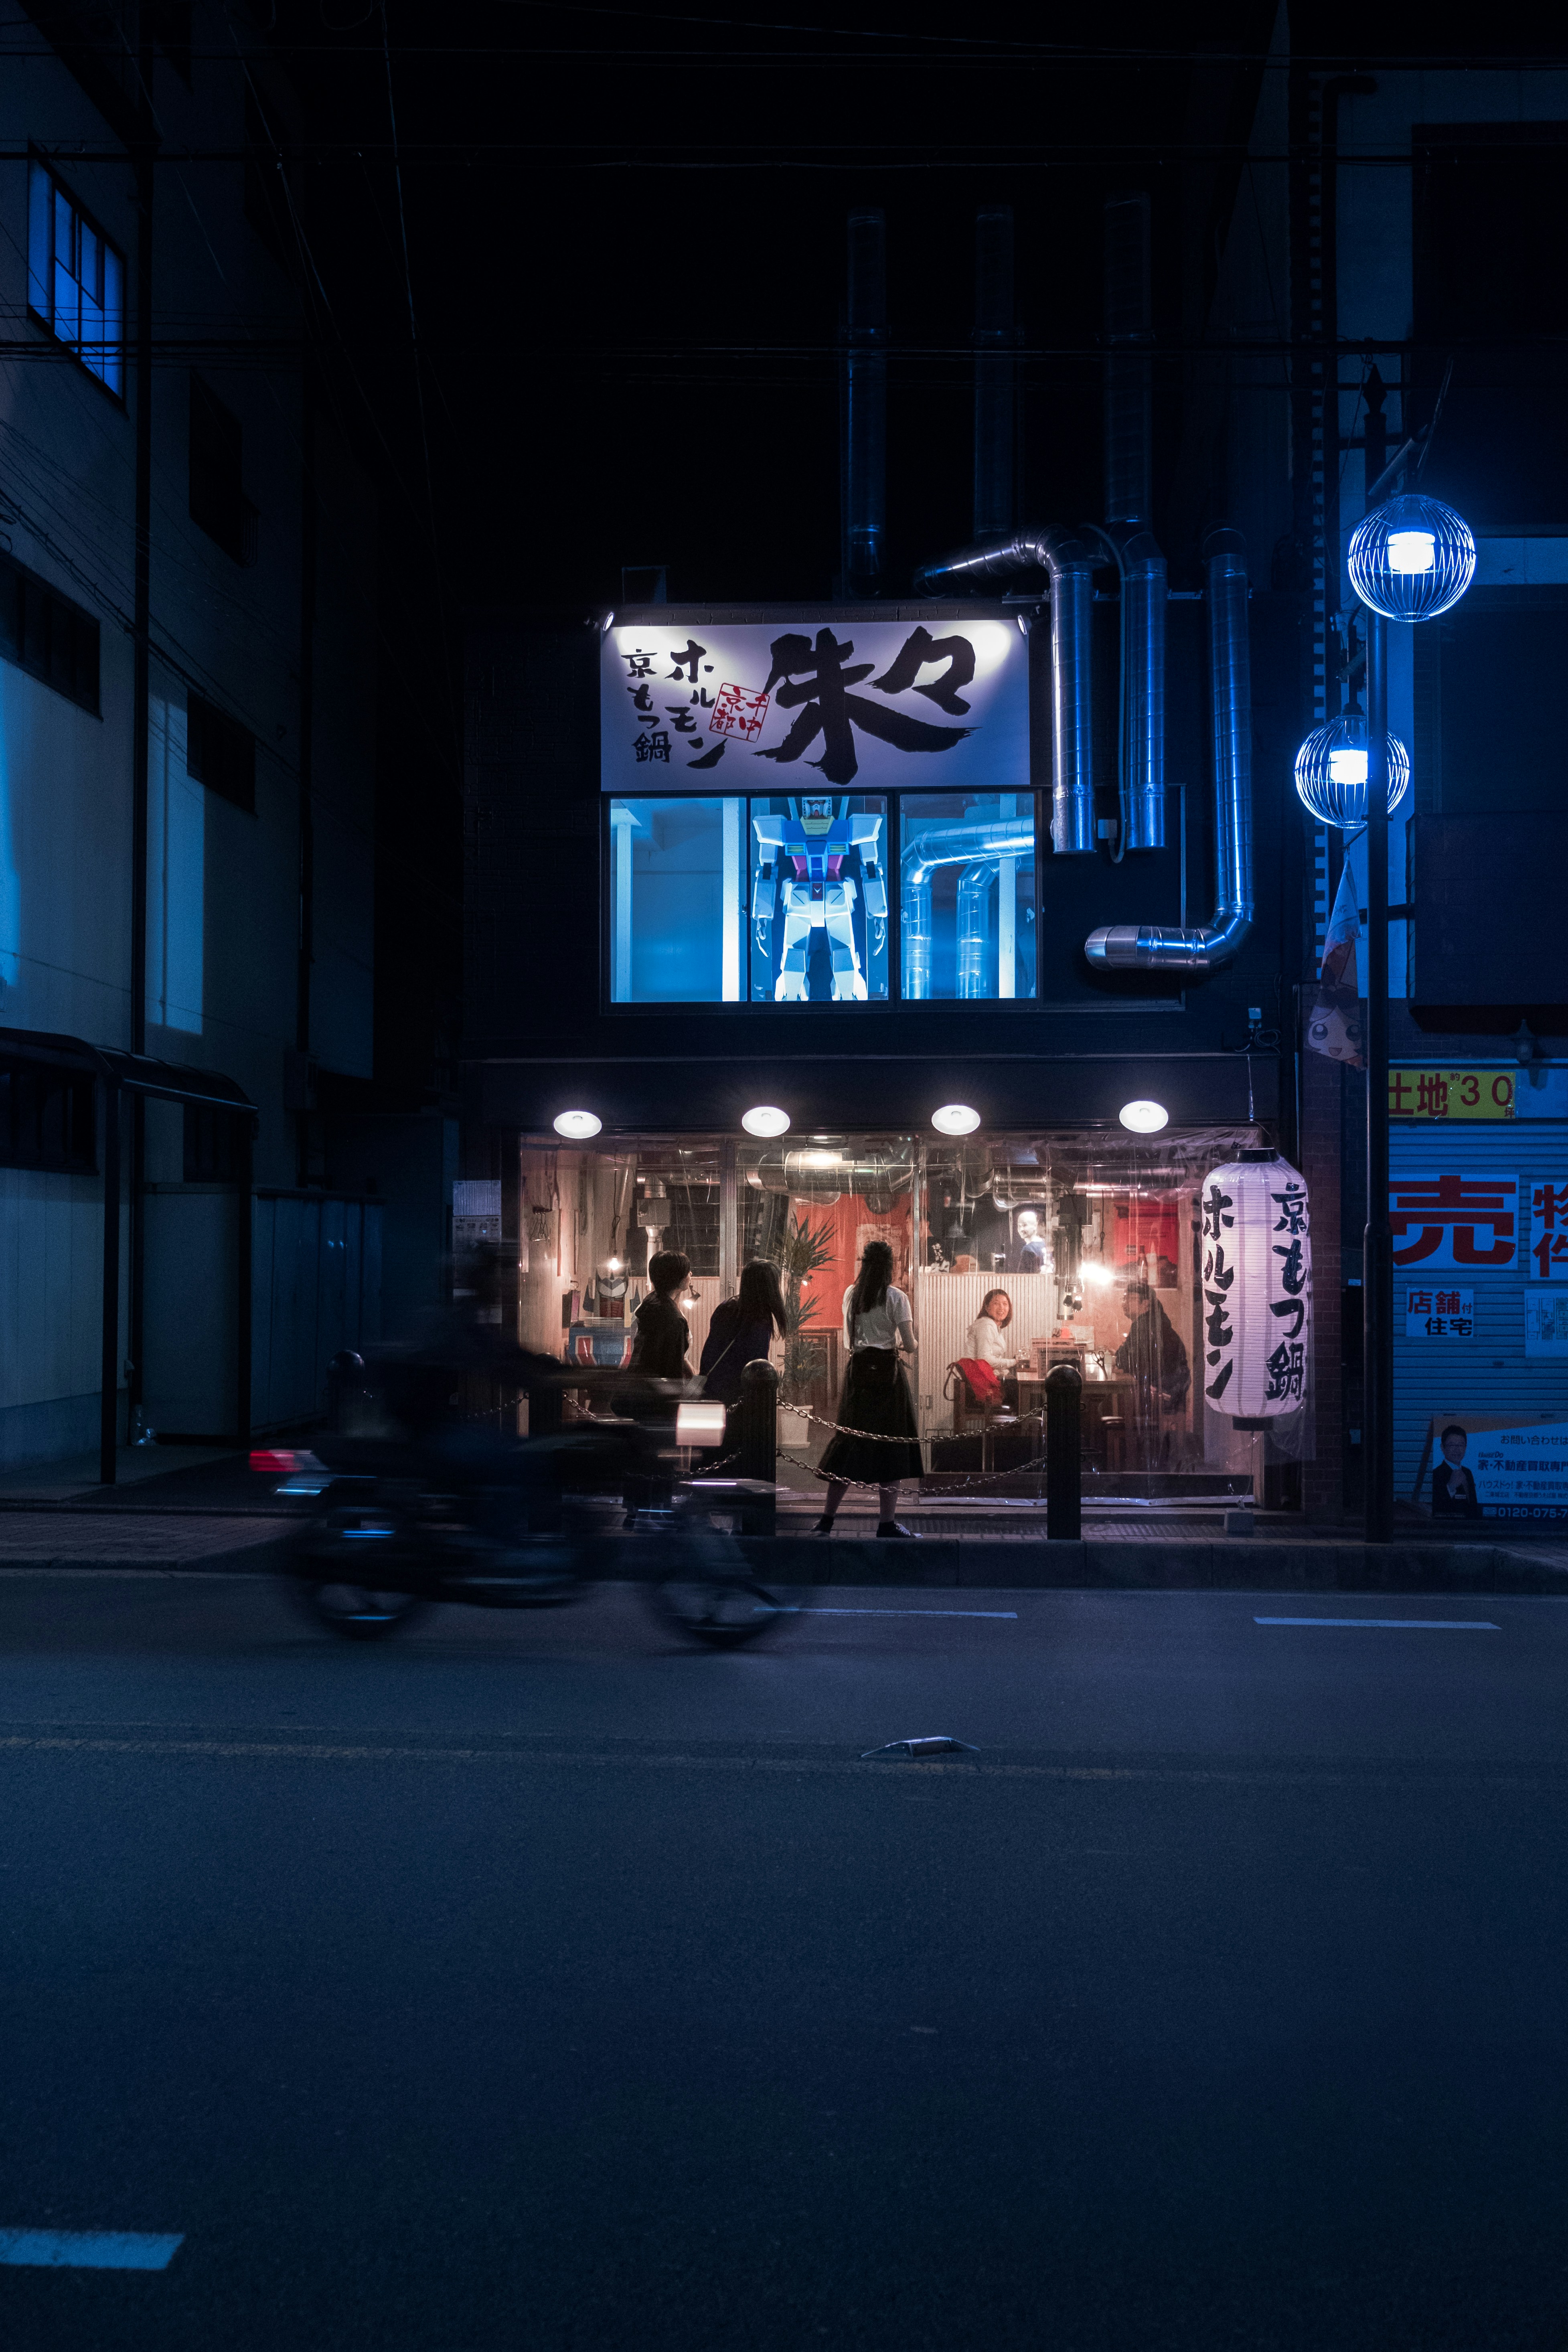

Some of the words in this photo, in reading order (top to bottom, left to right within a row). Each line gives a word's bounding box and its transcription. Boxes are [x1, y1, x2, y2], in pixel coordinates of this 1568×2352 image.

[621, 648, 673, 763] 京もつ鍋
[664, 639, 728, 769] ホルモン
[1389, 1175, 1516, 1266] 売
[1203, 1185, 1235, 1400] ホルモン
[1264, 1183, 1307, 1401] 京もつ鍋
[1424, 1317, 1472, 1336] 住宅
[1501, 1435, 1568, 1445] お問い合わせは
[1498, 1507, 1568, 1518] 0120-075-7
